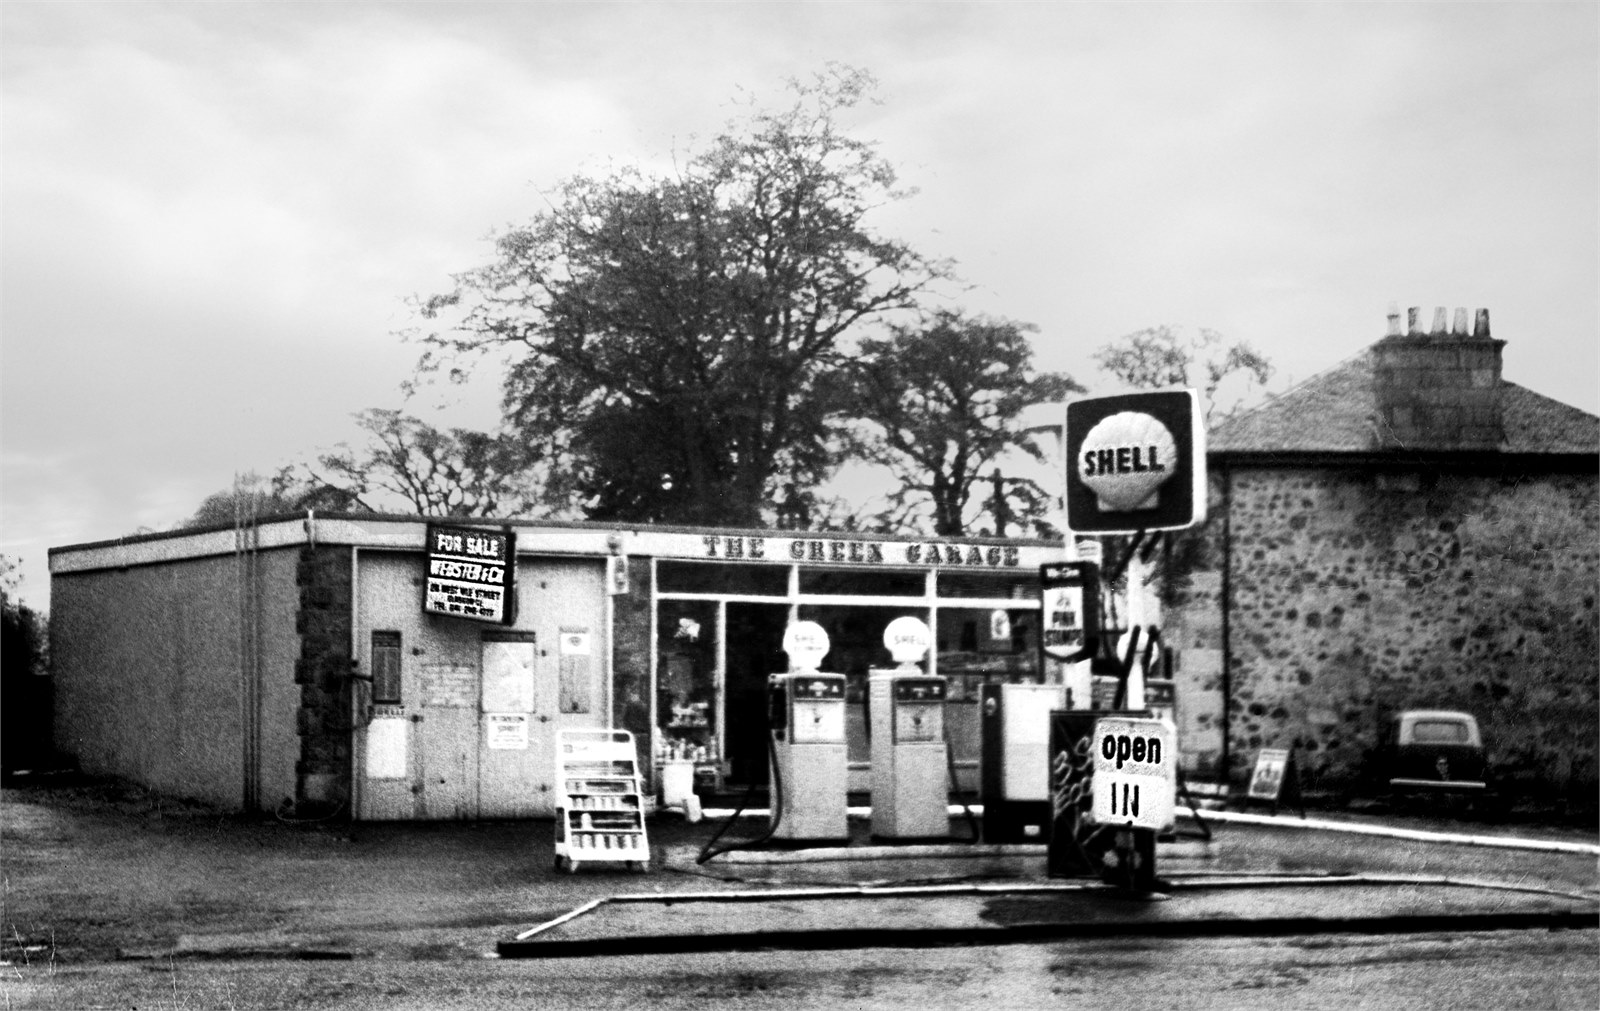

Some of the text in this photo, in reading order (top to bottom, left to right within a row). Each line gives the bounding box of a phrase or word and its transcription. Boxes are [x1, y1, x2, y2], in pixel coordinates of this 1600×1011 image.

[1084, 446, 1165, 477] SHELL
[437, 533, 499, 557] FOR SALE
[703, 536, 1019, 567] THE GREEN GARAGE
[894, 635, 927, 646] SHELL
[1102, 735, 1161, 769] open
[1111, 782, 1140, 818] IN
